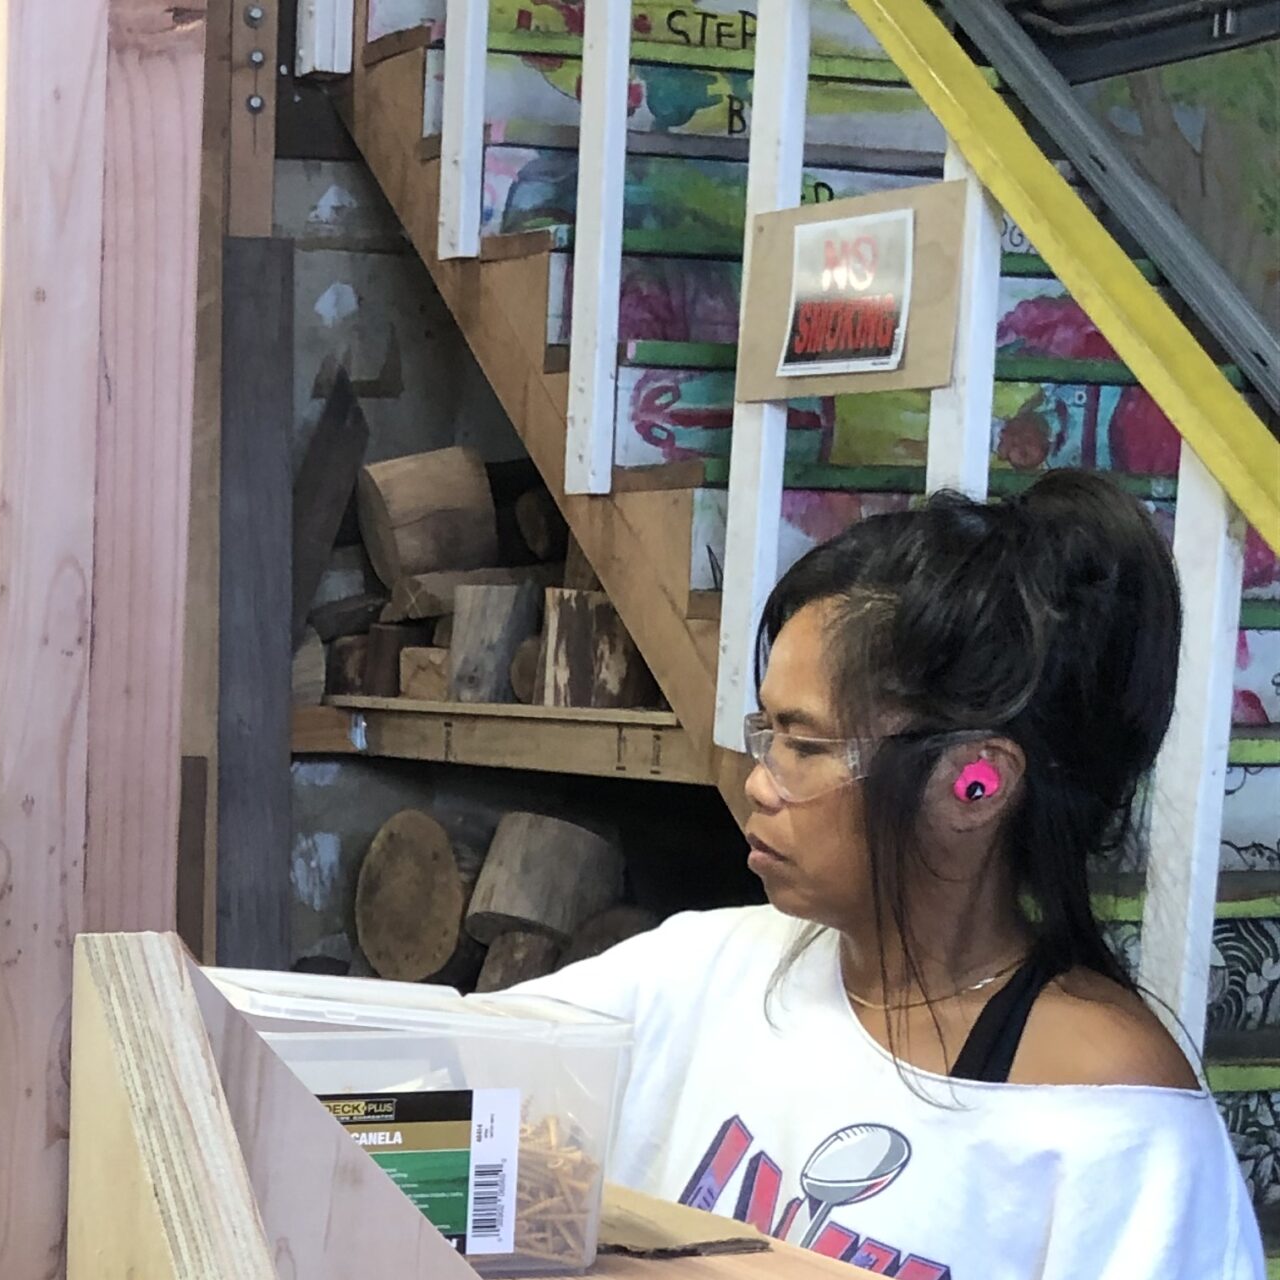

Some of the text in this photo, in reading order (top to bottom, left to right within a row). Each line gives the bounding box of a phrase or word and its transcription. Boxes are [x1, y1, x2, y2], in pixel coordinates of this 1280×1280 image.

[666, 9, 757, 49] STEP
[821, 235, 879, 291] NO
[793, 293, 897, 354] SMOKING
[350, 1131, 403, 1146] CANELA
